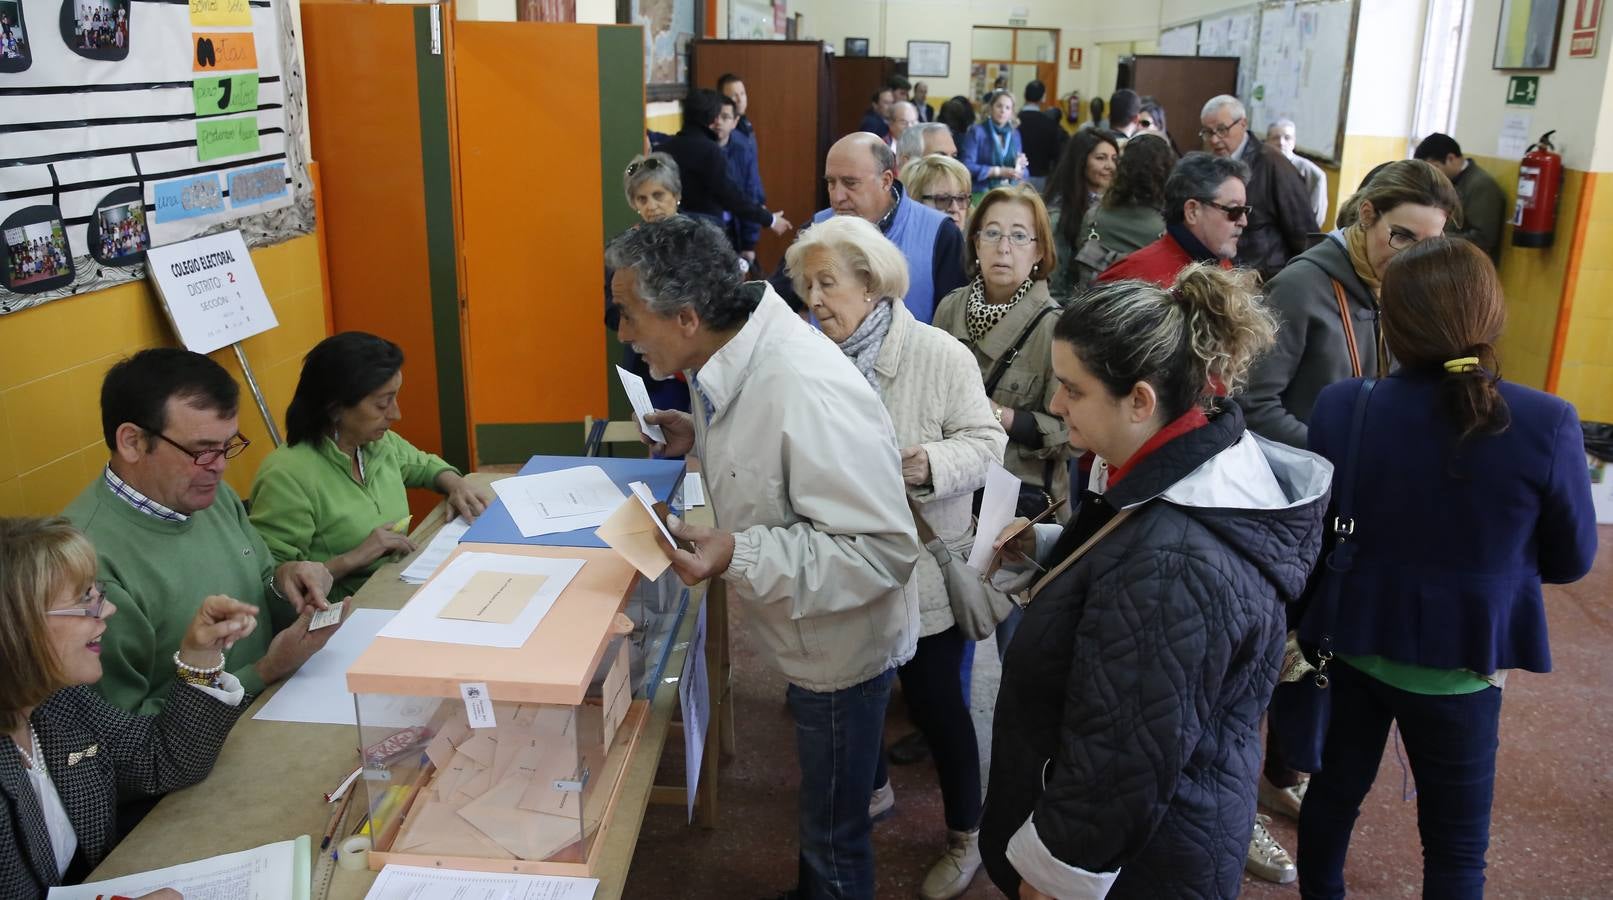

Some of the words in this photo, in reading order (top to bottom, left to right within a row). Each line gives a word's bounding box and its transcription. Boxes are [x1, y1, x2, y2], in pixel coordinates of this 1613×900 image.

[171, 257, 201, 278] COLEGIO
[199, 249, 236, 271] ELECTORAL
[227, 271, 237, 283] 2
